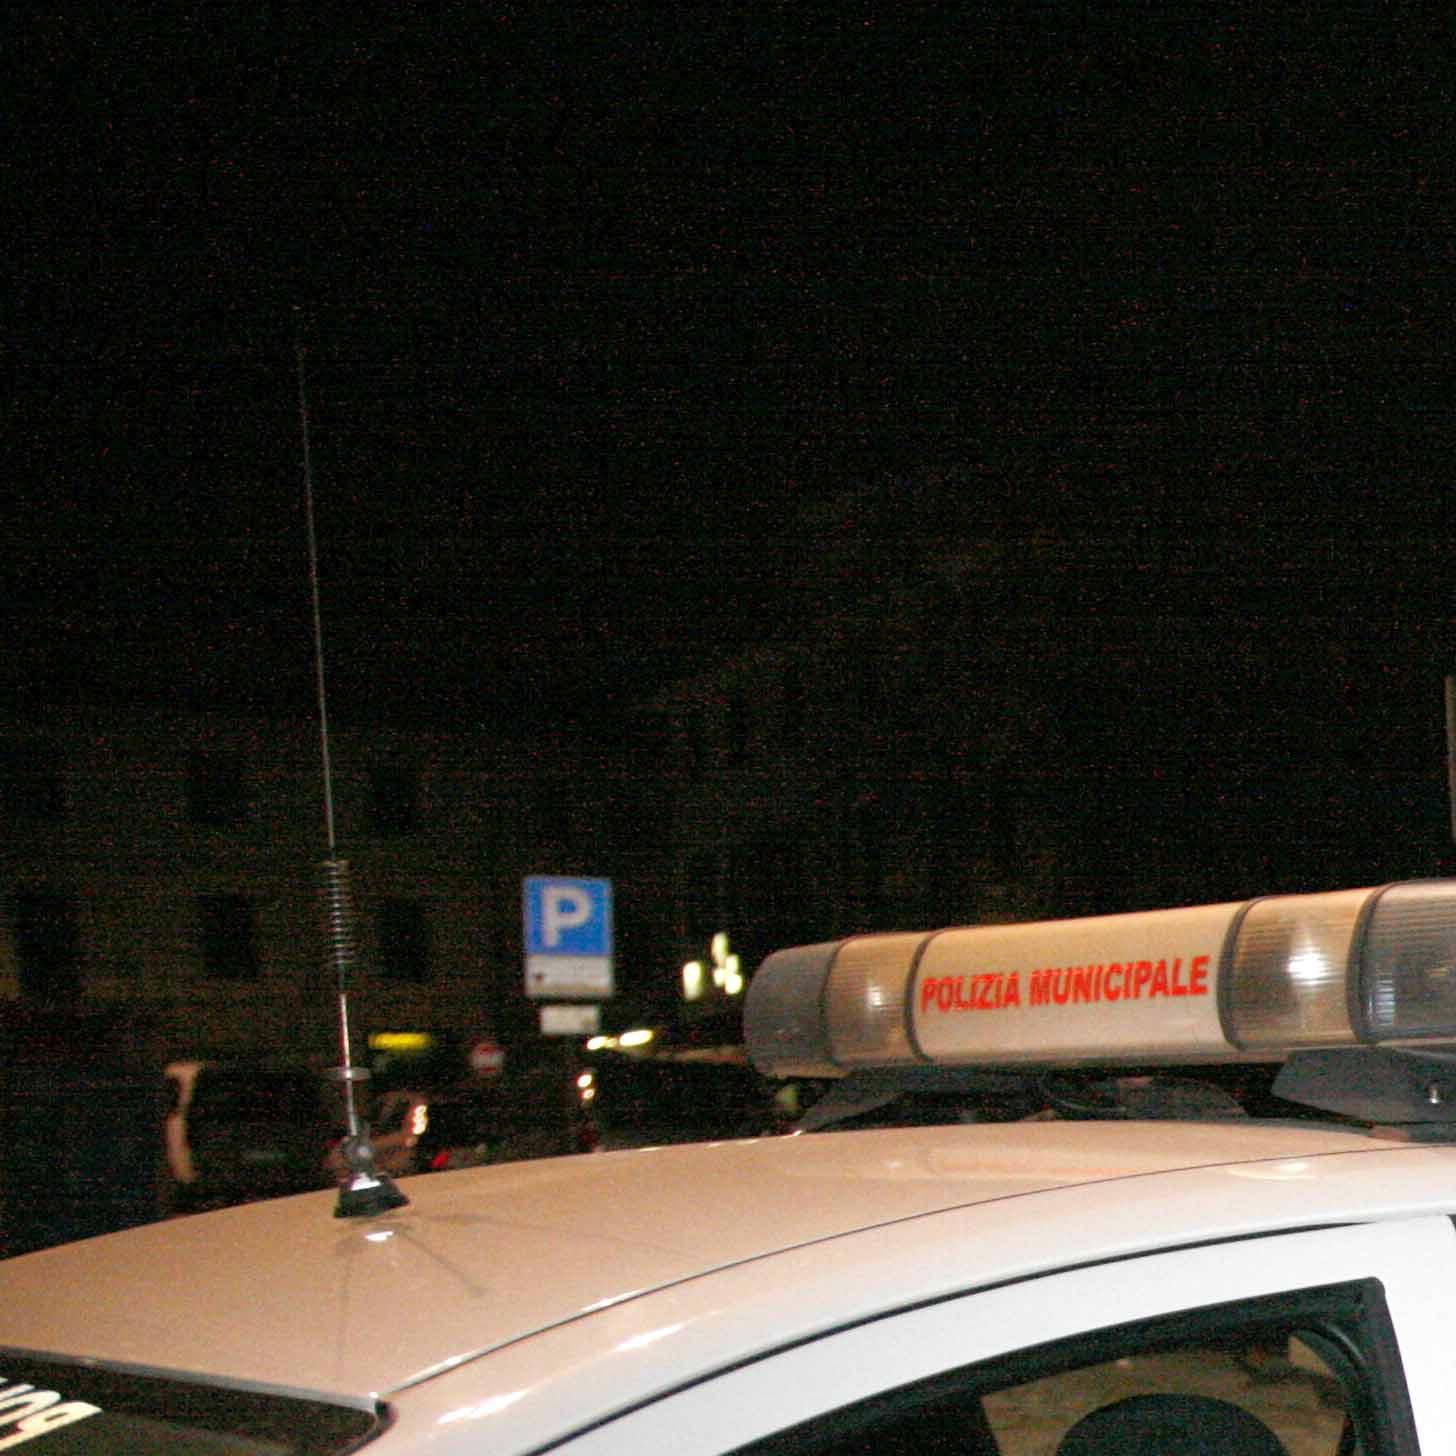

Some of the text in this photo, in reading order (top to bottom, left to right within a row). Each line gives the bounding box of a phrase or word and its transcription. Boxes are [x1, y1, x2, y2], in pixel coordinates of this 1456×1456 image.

[541, 886, 592, 947] P
[920, 954, 1211, 1014] POLIZIA MUNICIPALE
